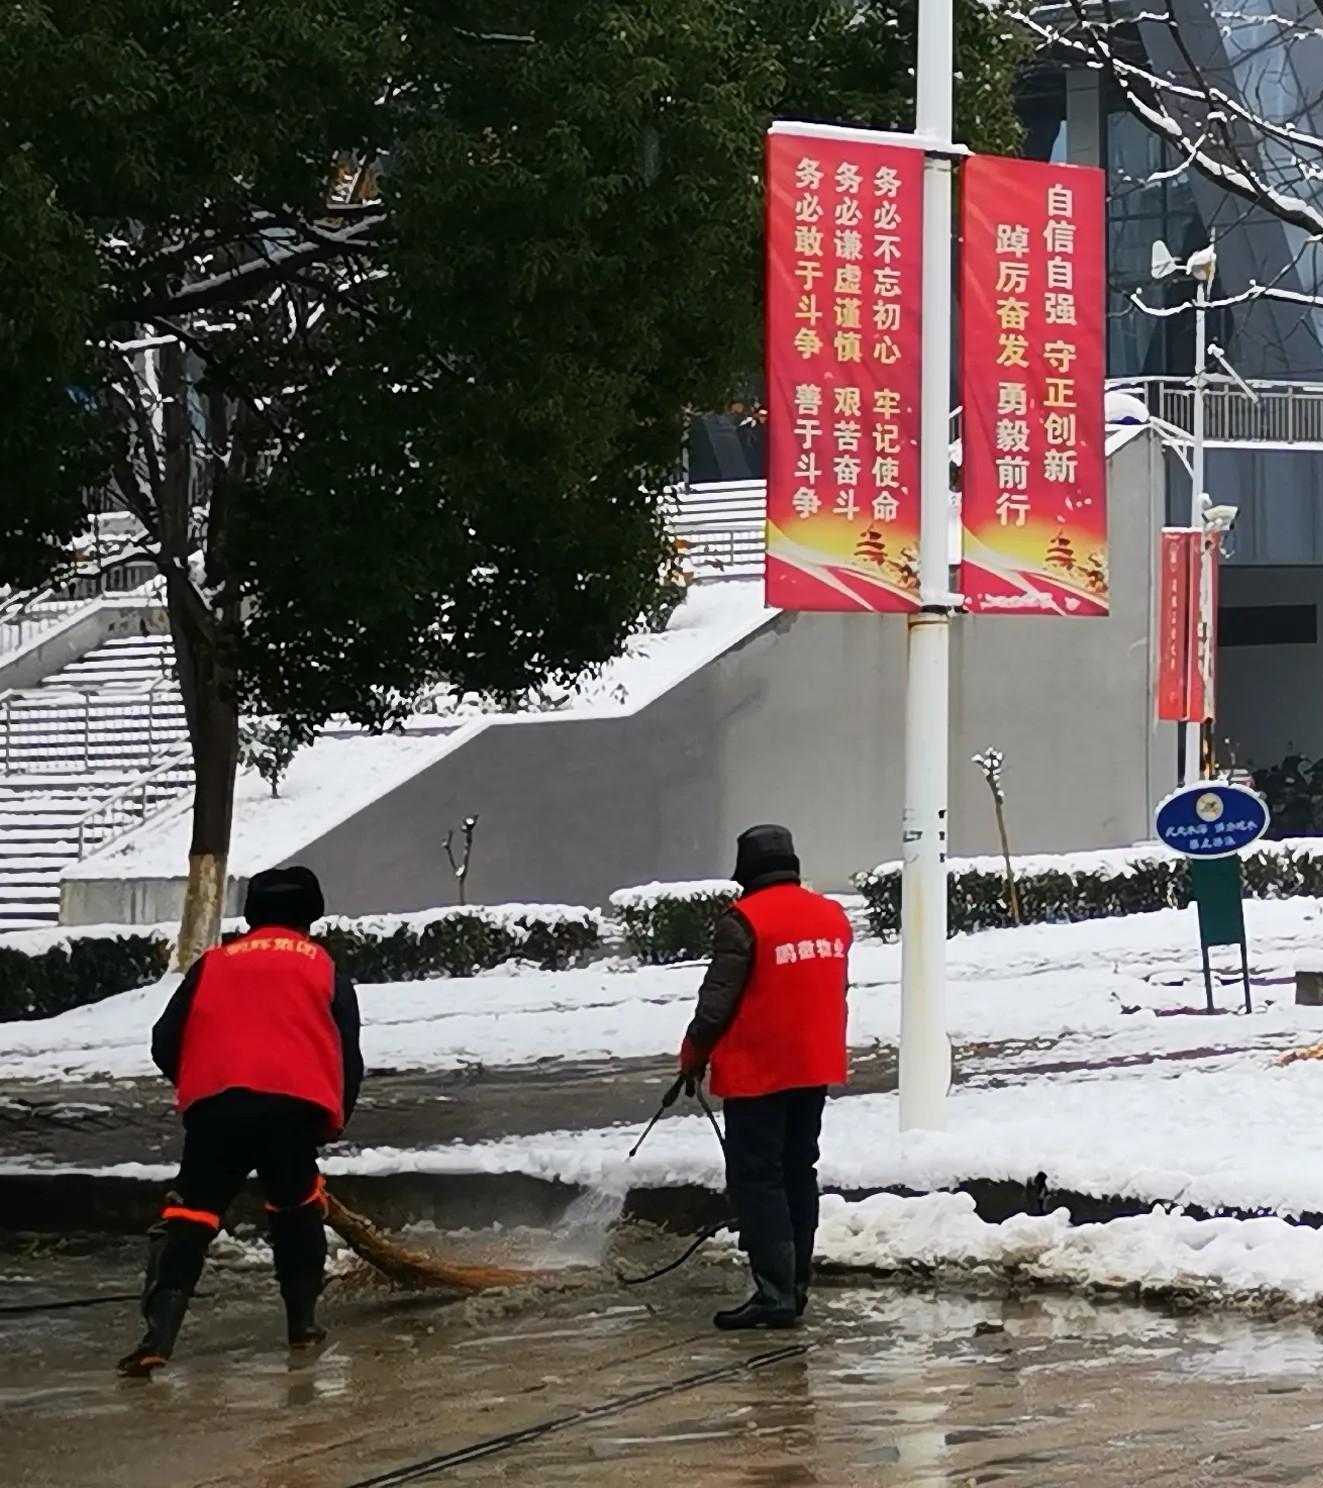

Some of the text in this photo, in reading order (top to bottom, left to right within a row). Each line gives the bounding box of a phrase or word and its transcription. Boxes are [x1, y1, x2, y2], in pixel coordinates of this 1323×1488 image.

[792, 157, 824, 519] 务必敢于斗争 善于斗争
[832, 161, 863, 522] 务必谦虚谨慎 艰苦奋斗
[871, 165, 902, 519] 务必不忘初心 牢记使命
[995, 223, 1031, 527] 踔厉奋发 勇毅前行
[1043, 183, 1077, 484] 自信自强 守正创新
